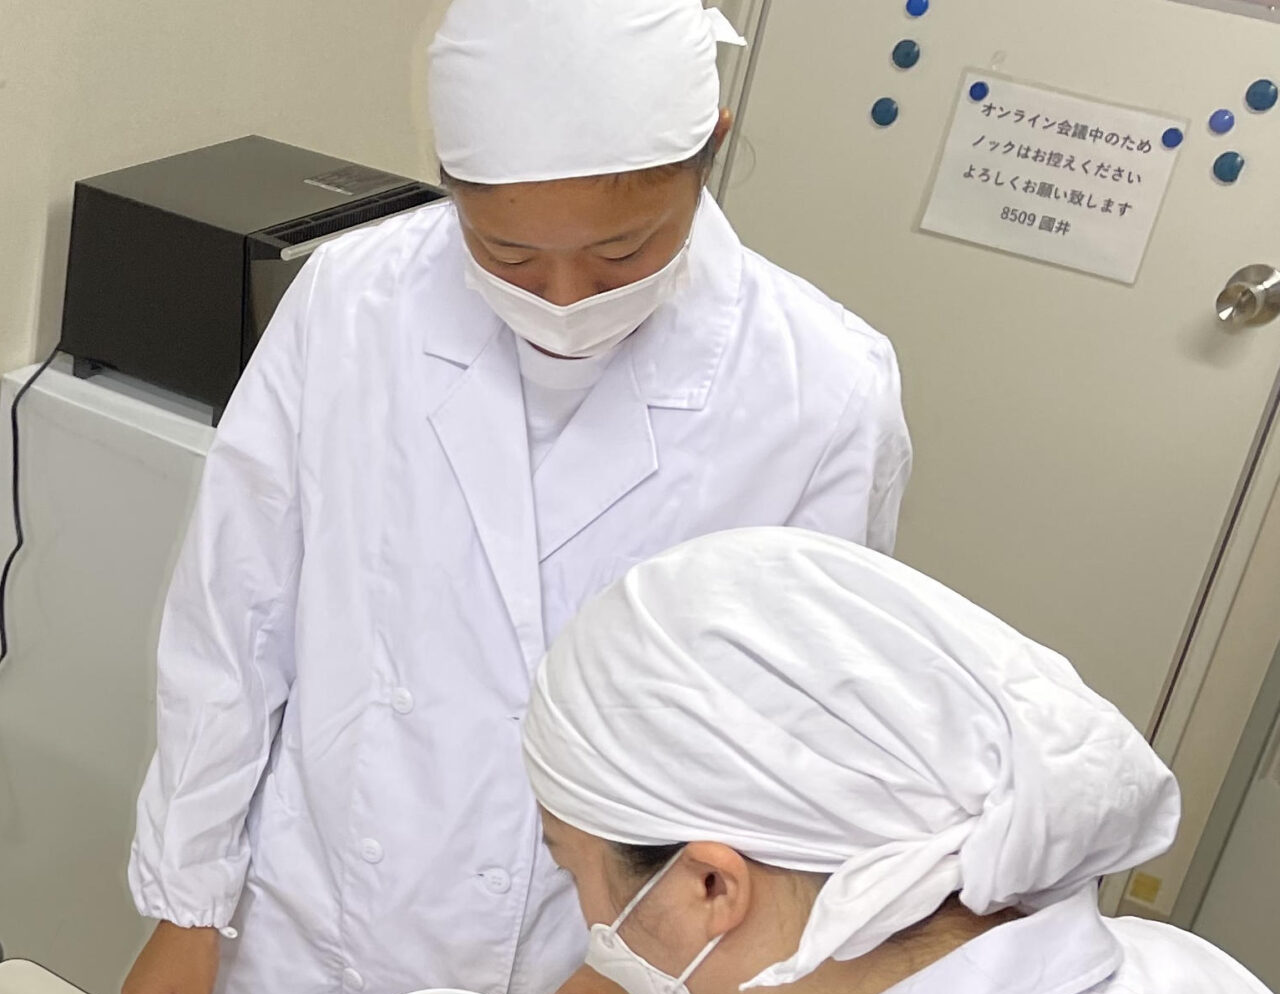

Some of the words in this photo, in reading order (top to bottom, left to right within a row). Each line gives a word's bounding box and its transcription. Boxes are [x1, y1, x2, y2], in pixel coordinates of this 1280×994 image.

[981, 102, 1152, 153] オンライン会議中のため
[972, 135, 1142, 184] ノックはお控えください
[963, 164, 1133, 217] よろしくお願い致します
[1000, 206, 1036, 227] 8509
